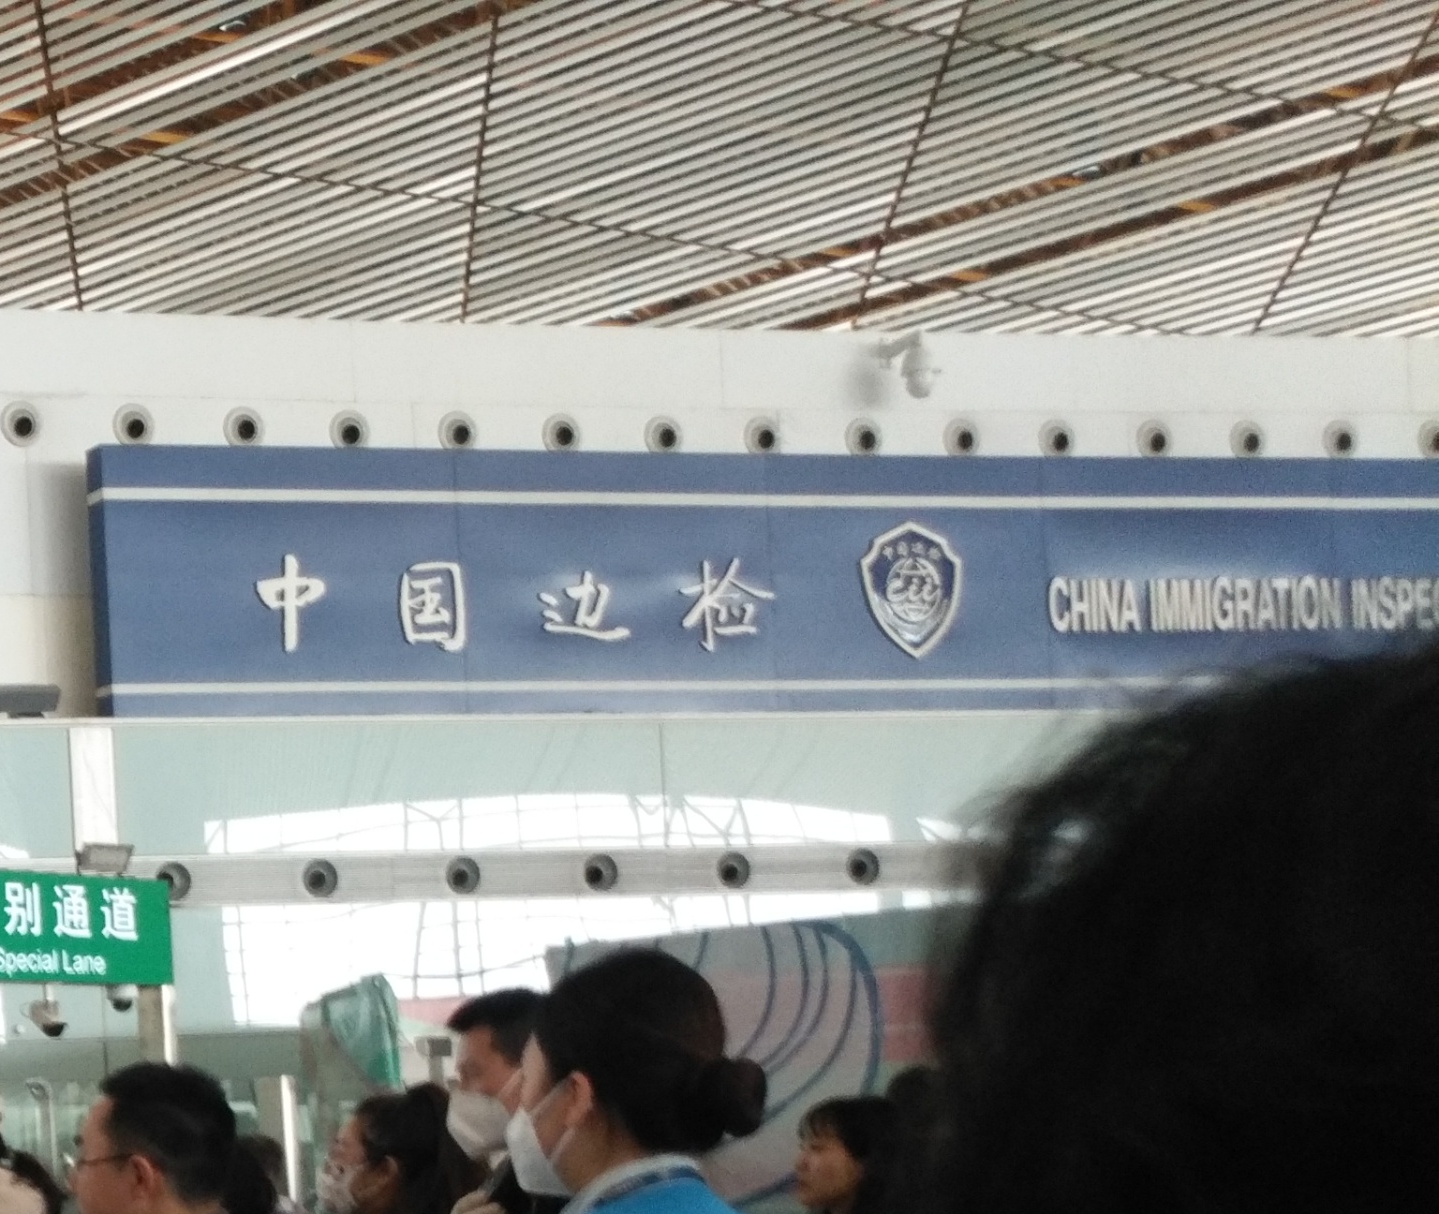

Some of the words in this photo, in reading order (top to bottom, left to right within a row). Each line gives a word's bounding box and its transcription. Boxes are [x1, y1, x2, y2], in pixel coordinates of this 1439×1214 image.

[256, 553, 775, 653] 中国边检
[1049, 575, 1142, 633] CHINA
[1150, 574, 1342, 632] IMMIGRATION
[1350, 575, 1439, 631] INSPE
[61, 949, 107, 976] Lane
